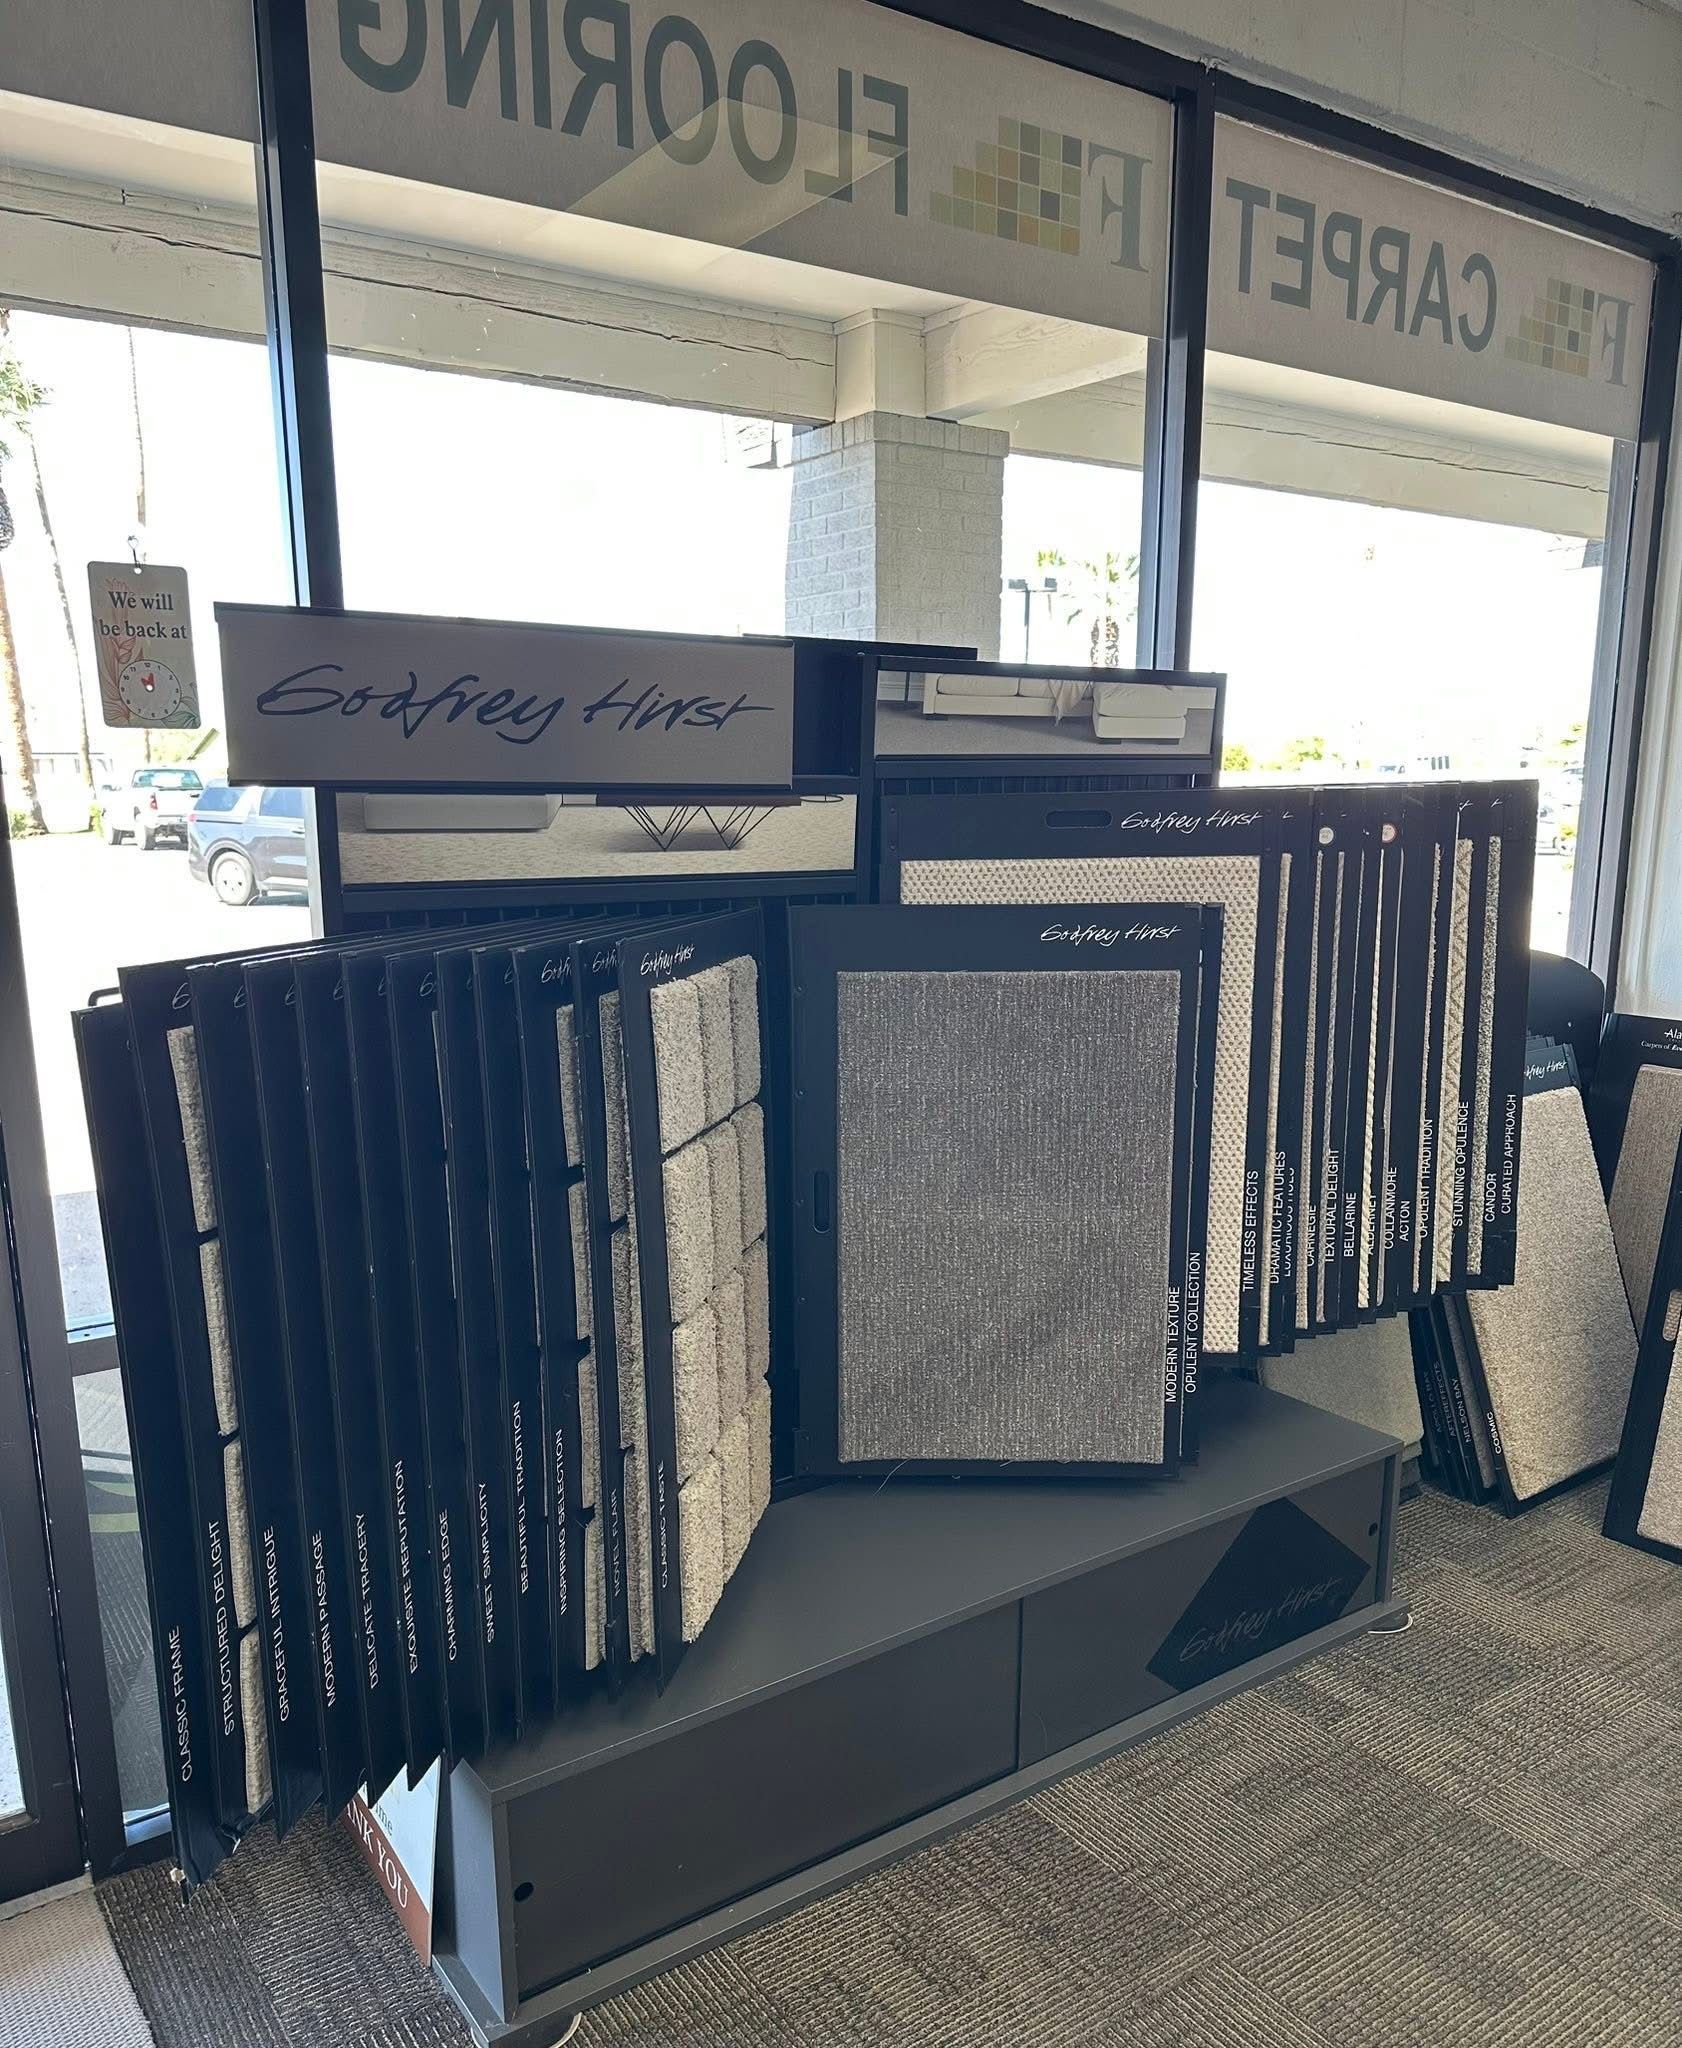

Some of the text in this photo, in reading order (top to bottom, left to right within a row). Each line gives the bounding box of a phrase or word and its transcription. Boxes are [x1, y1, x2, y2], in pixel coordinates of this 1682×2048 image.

[99, 619, 187, 639] be back at
[108, 591, 174, 611] We will
[256, 664, 774, 745] Godfrey Hirst
[1120, 812, 1202, 834] Godfrey
[1205, 809, 1264, 828] Hirst
[1040, 923, 1183, 945] Godfrey Hirst
[1324, 1150, 1339, 1262] TEXTURAL DELIGHT
[1421, 1119, 1433, 1182] TRADITION
[1453, 1101, 1469, 1227] STUNNING OPULENCE
[1485, 1172, 1497, 1222] CANDOR
[1501, 1094, 1517, 1214] CURATED APPROACH
[1243, 1170, 1259, 1292] TIMELESS EFFECTS
[1270, 1151, 1286, 1284] DRAMATIC FEATURES
[1307, 1205, 1317, 1267] CARNEGIE
[1343, 1192, 1357, 1257] BELLARINE
[1384, 1167, 1397, 1249] COLLANMORE
[1399, 1200, 1410, 1241] ACTON
[1165, 1286, 1181, 1403] MODERN TEXTURE
[1184, 1252, 1201, 1393] OPULENT COLLECTION
[1452, 1378, 1472, 1443] NELSON BAY
[1486, 1411, 1502, 1455] COSMIC
[512, 1400, 529, 1594] BEAUTIFUL TRADITION
[555, 1428, 568, 1616] INSPIRING SELECTION
[659, 1517, 669, 1589] CLASSIC
[311, 1529, 336, 1708] MODERN PASSAGE
[355, 1513, 379, 1689] DELICATE TRACERY
[394, 1459, 418, 1674] EXQUISITE REPUTATION
[439, 1508, 457, 1661] CHARMING EDGE
[478, 1482, 495, 1643] SWEET SIMPLICITY
[208, 1520, 235, 1736] STRUCTURED DELIGHT
[263, 1525, 290, 1722] GRACEFUL INTRIGUE
[1179, 1577, 1345, 1662] Godfrey Hirst
[168, 1625, 193, 1782] CLASSIC FRAME
[376, 1837, 409, 1909] YOU
